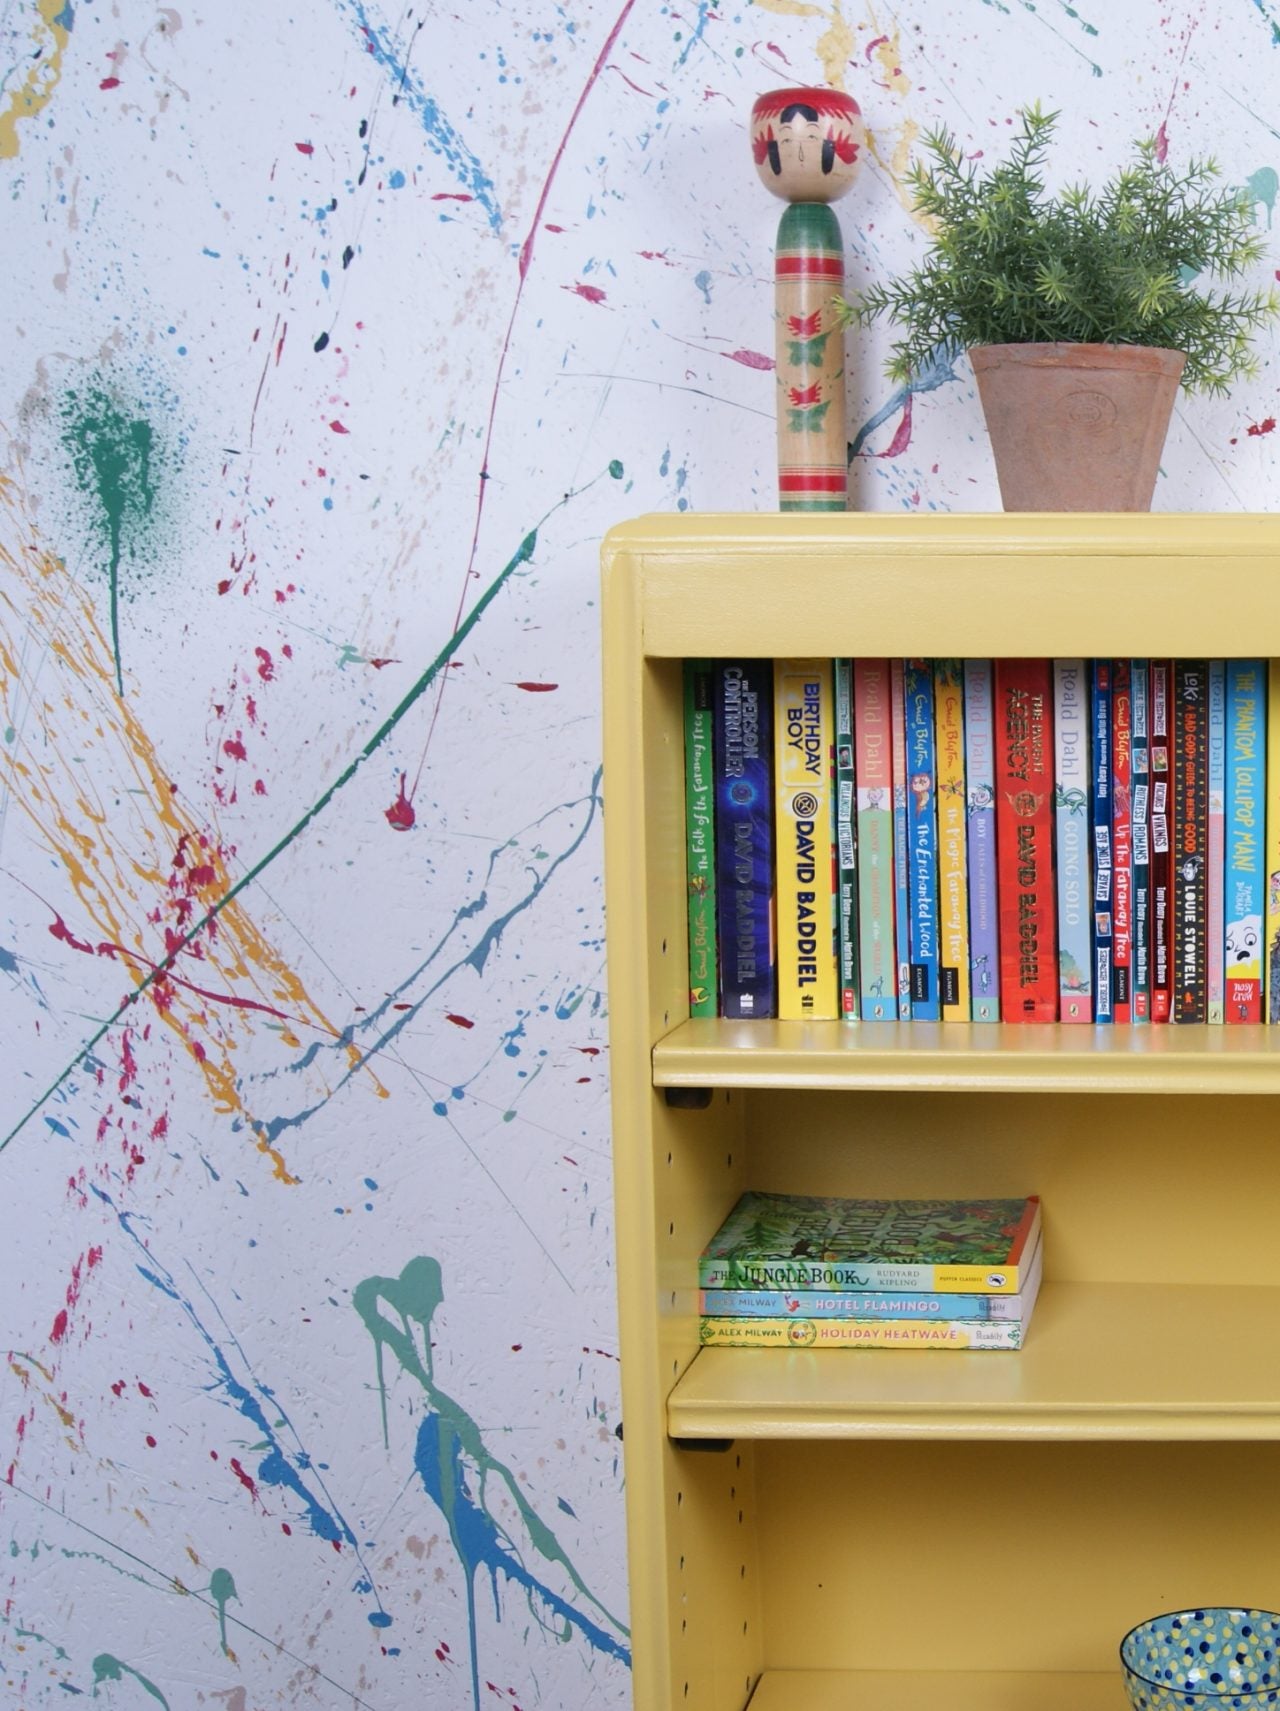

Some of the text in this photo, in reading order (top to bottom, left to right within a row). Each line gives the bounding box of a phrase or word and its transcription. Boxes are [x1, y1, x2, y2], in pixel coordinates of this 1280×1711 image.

[724, 667, 744, 777] CONTROLLER
[742, 692, 758, 758] PERSON
[788, 708, 802, 750] BOY
[804, 683, 820, 775] BIRTHDAY
[864, 671, 882, 778] Roald Dahl
[914, 694, 928, 767] Enid Blyton
[945, 697, 956, 768] Enid Blyton
[969, 671, 988, 777] Roald Dahl
[1006, 688, 1029, 782] AGENCY
[1032, 695, 1043, 774] THE PARENT
[1061, 668, 1079, 775] Roald Dahl
[1097, 720, 1106, 738] Martin
[1116, 697, 1129, 768] Enid Blyton
[1185, 713, 1195, 732] BAD
[1211, 673, 1222, 781] Roald Dahl
[692, 714, 709, 871] The Folk of the Faraway Tree
[1097, 783, 1107, 798] Terry
[1185, 761, 1195, 785] GUIDE
[1232, 671, 1256, 871] THE PHANTOM LOLLIPOP MAN!
[840, 782, 852, 865] VILLAINOUS VICTORIANS
[977, 818, 985, 838] BOY
[1135, 787, 1146, 860] RUTHLESS ROMANS
[1155, 785, 1166, 846] VICIOUS VIKINGS
[1185, 823, 1196, 853] GOOD
[1186, 798, 1194, 820] BEING
[796, 821, 814, 883] DAVID
[946, 827, 961, 867] Magic
[1065, 821, 1079, 925] GOING SOLO
[1097, 831, 1109, 898] SAVAGE STONE AGE
[735, 823, 755, 983] DAVID BADDIEL
[915, 822, 933, 957] The Enchanted Wood
[947, 871, 962, 929] Faraway
[1018, 825, 1038, 988] DAVID BADDIEL
[1115, 824, 1129, 958] Up The Faraway Tree
[1137, 888, 1146, 902] Terry
[1156, 887, 1165, 900] Terry
[1156, 902, 1166, 918] Deary
[1235, 881, 1246, 916] BUTCHART
[1244, 885, 1252, 911] PAMELA
[797, 892, 816, 987] BADDIEL
[843, 941, 852, 960] Martin
[949, 934, 962, 961] Tree
[1138, 947, 1146, 965] Martin
[1157, 945, 1166, 963] Martin
[1185, 885, 1195, 986] LOUIE STOWELL
[844, 961, 852, 979] Brown
[1138, 966, 1146, 984] Brown
[1157, 965, 1166, 983] Brown
[792, 1218, 831, 1237] THE
[713, 1266, 869, 1285] THE JUNGLE BOOK
[815, 1300, 940, 1312] HOTEL FLAMINGO
[821, 1330, 957, 1339] HOLIDAY HEATWAVE
